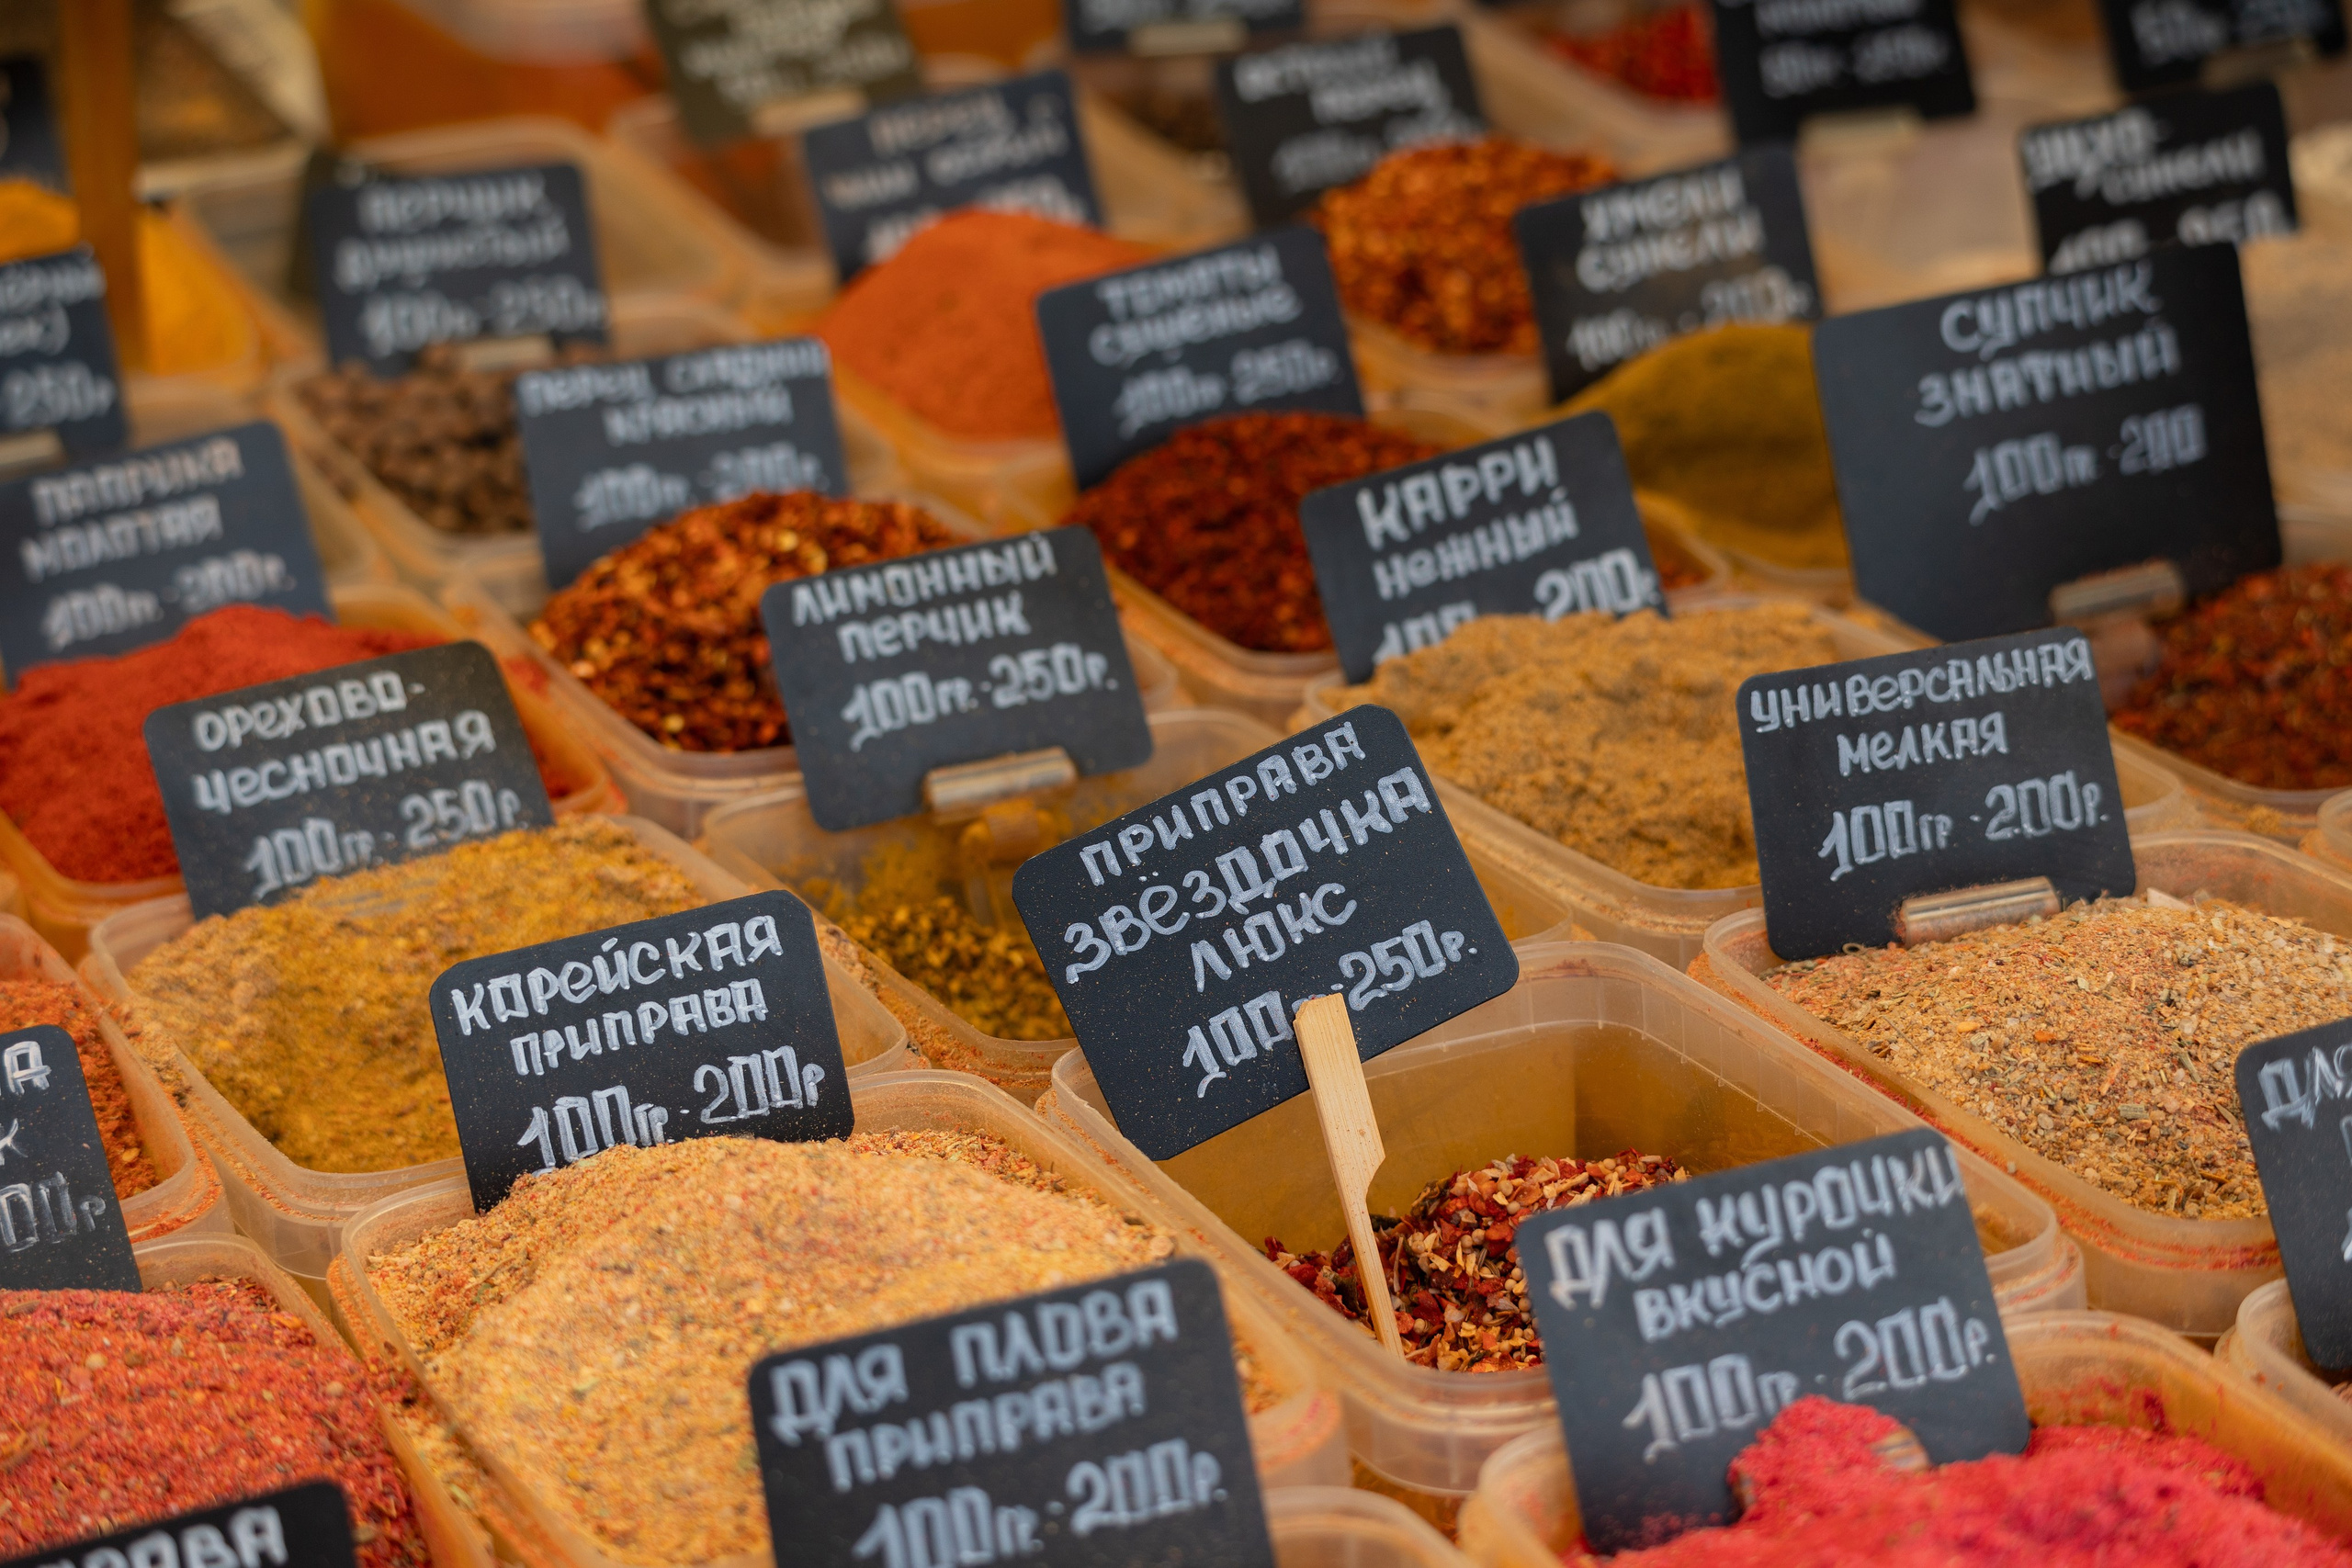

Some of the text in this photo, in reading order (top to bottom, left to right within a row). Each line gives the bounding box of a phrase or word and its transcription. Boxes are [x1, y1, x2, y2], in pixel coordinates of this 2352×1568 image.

[1097, 242, 1283, 321] ТОМАТЫ
[1939, 258, 2162, 361] СУПЧИК
[1914, 319, 2182, 428] ЗНАТНЫЙ
[30, 435, 245, 528] ПАПРИКА
[1355, 434, 1559, 549] КАРРИ
[19, 493, 223, 584] МОЛОТАЯ
[791, 530, 1057, 627] ЛИМОННЫЙ
[1372, 485, 1580, 601] НЕЖНЫЙ
[837, 590, 1032, 663] ПЕРЧИК
[1749, 637, 2096, 733] УНИВЕРСАЛЬНАЯ
[191, 709, 496, 815] ЧЕСНОЧНАЯ
[1836, 711, 2009, 777] МЕЛКАЯ
[1079, 721, 1366, 886] ПРИПРАВА
[1063, 766, 1432, 984] ЗВЁЗДОЧКА
[450, 914, 785, 1036] КОРЕЙСКАЯ
[1190, 882, 1358, 993] ЛЮКС
[510, 977, 769, 1077] ПРИПРАВА
[1544, 1145, 1965, 1309] ДЛЯ КУРОЧКИ
[1633, 1228, 1897, 1342] ВКУСНОЙ
[769, 1278, 1179, 1446] ДЛЯ ПЛОВА
[827, 1360, 1147, 1493] ПРИПРАВА
